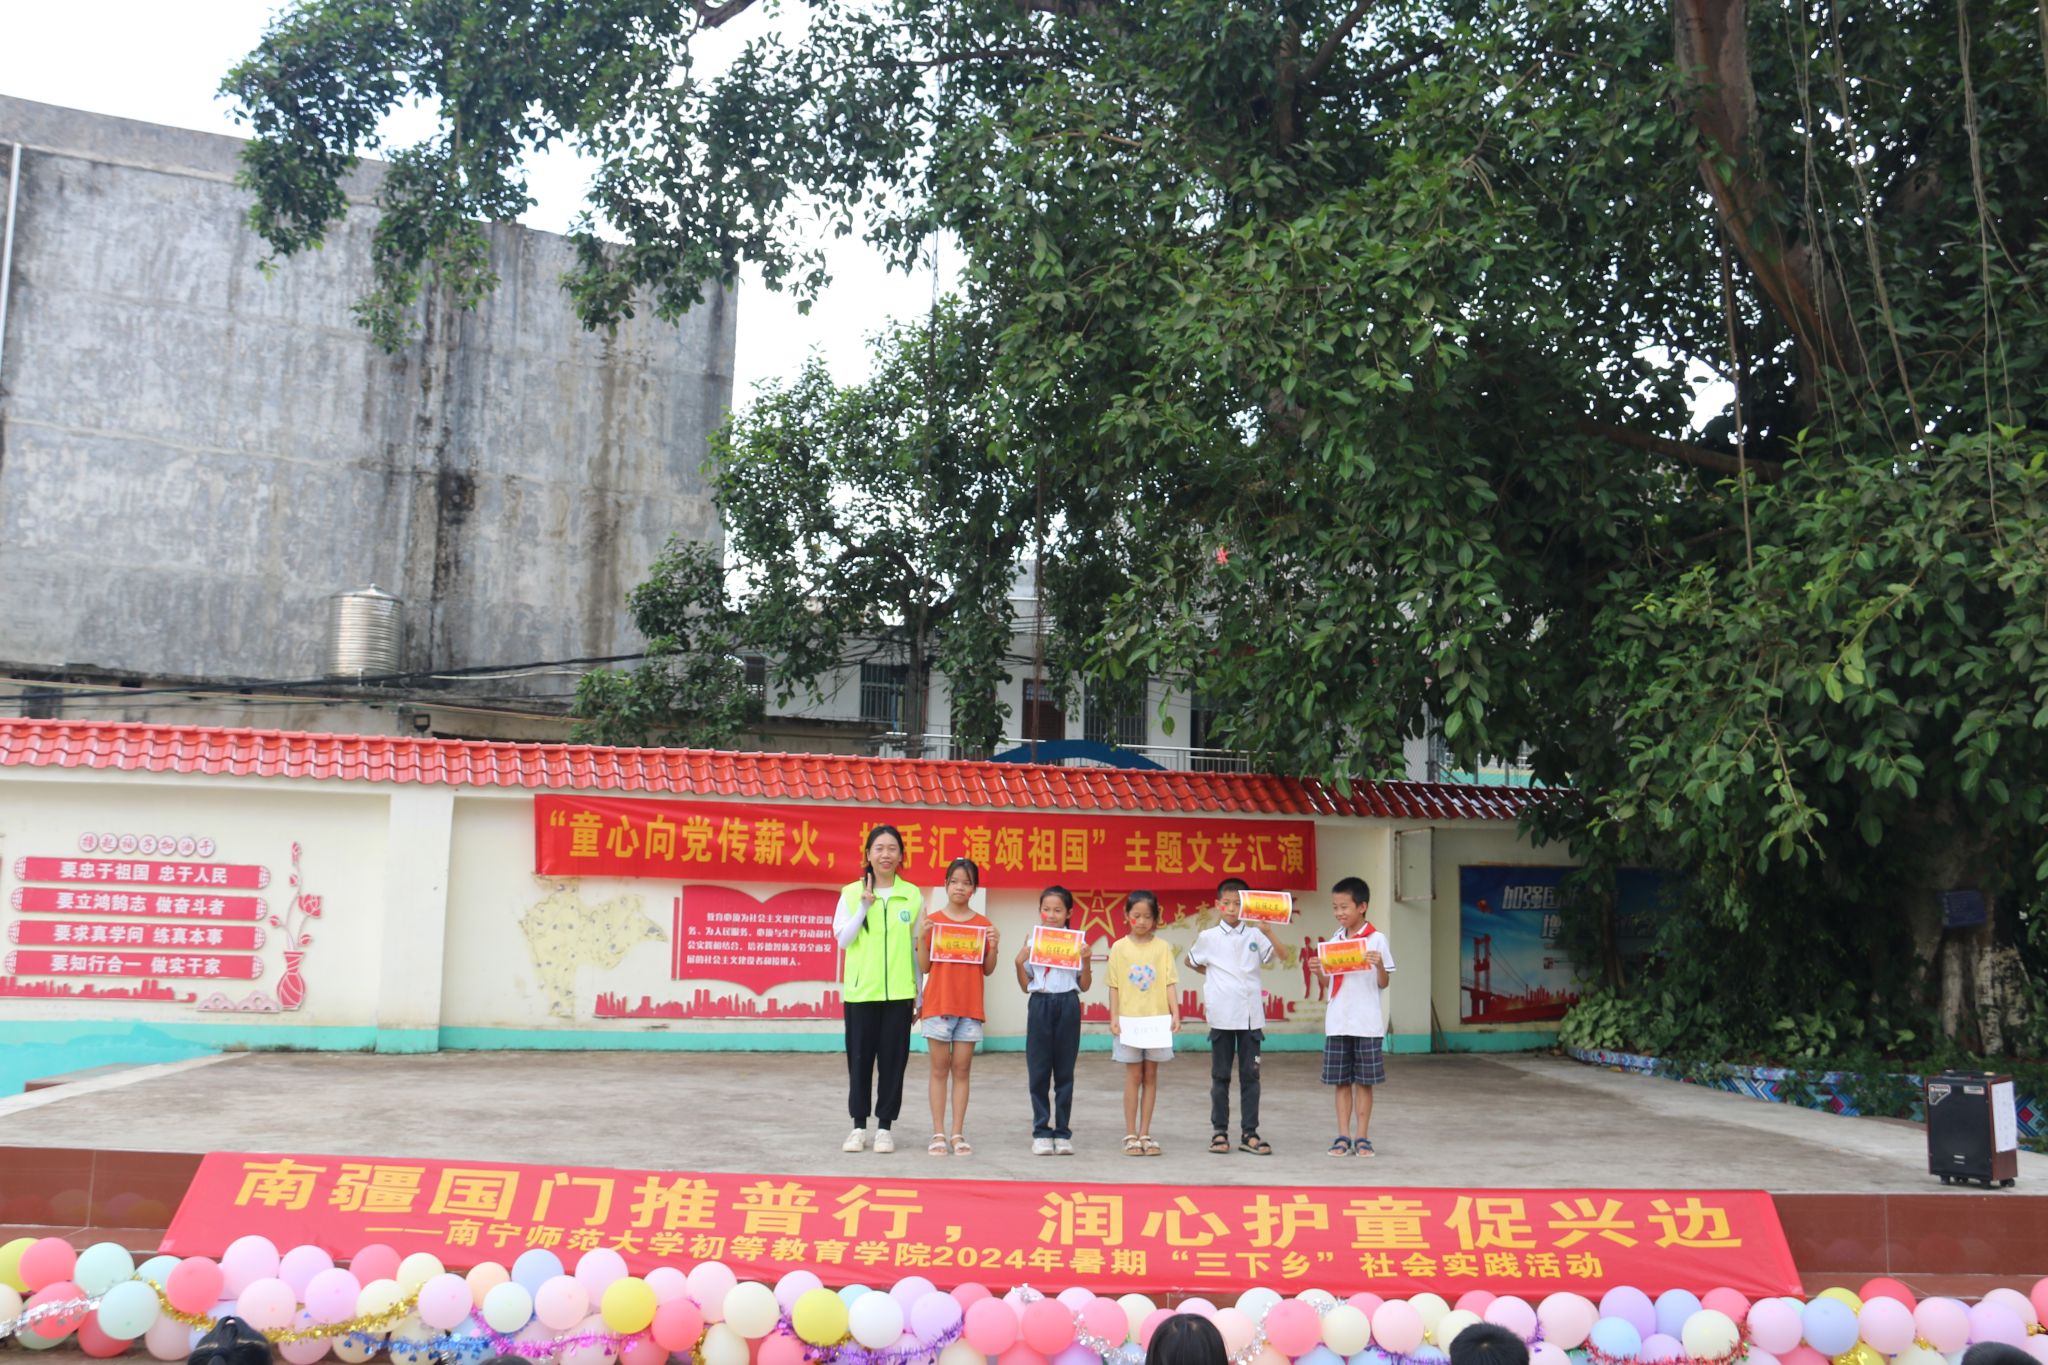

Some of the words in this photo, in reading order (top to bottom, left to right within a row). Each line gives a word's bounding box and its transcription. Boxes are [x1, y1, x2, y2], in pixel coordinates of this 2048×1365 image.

[60, 861, 149, 881] 要忠于祖国
[158, 866, 228, 884] 忠于人民
[57, 892, 147, 912] 要立鸿鹄志
[156, 896, 225, 916] 做奋斗者
[54, 924, 144, 943] 要求真学问
[152, 926, 223, 946] 练真本事
[50, 954, 142, 972] 要知行合一
[151, 957, 221, 975] 做实干家
